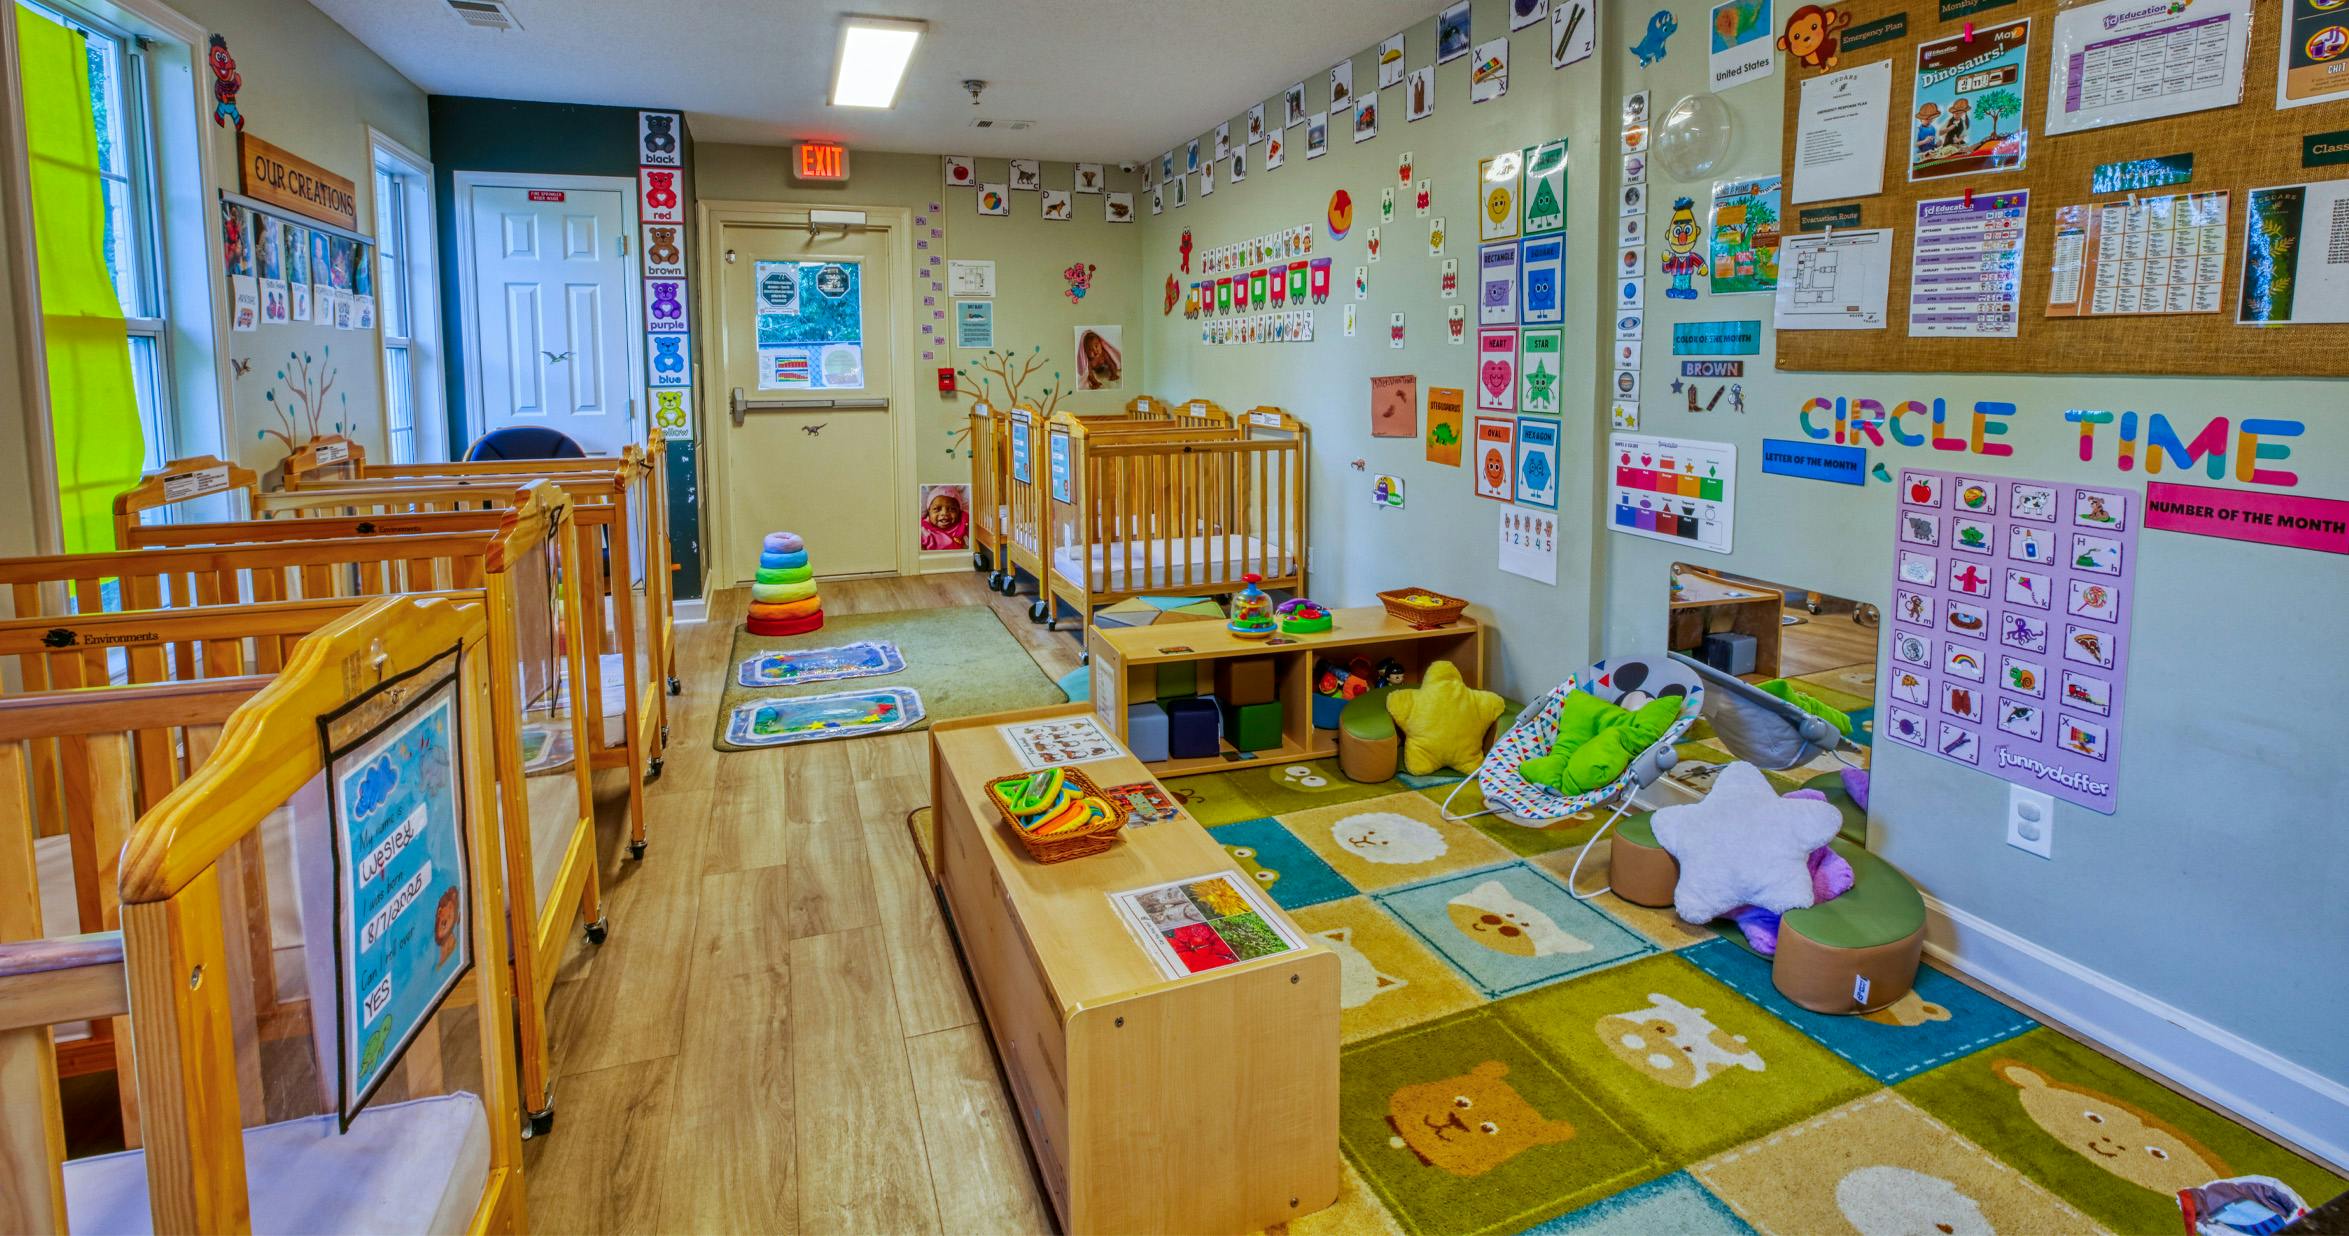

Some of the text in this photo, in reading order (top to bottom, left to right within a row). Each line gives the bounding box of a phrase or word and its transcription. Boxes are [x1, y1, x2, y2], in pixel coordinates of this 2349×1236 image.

[1942, 0, 1978, 12] Monthly
[1554, 8, 1562, 24] Z
[2119, 4, 2166, 21] Education
[1439, 12, 1447, 25] W
[1842, 22, 1904, 45] Emergency Plan
[1994, 29, 2018, 41] May
[1379, 46, 1386, 56] U
[1585, 41, 1591, 51] z
[1474, 49, 1482, 63] X
[1716, 58, 1769, 82] United States
[1922, 42, 2005, 88] Dinosaurs!
[2328, 62, 2346, 74] CHIT
[1408, 75, 1414, 85] V
[1830, 75, 1858, 85] CEDARS
[2313, 143, 2349, 154] Class
[646, 154, 675, 164] black
[801, 145, 843, 177] EXIT
[255, 155, 354, 217] OUR CREATIONS
[978, 184, 984, 192] B
[1042, 191, 1049, 199] D
[653, 211, 671, 220] red
[1801, 212, 1858, 225] Evacuation Route
[1485, 250, 1515, 264] RECTANGLE
[648, 265, 681, 275] brown
[650, 320, 685, 331] purple
[1489, 340, 1507, 349] HEART
[1534, 340, 1549, 349] STAR
[1676, 335, 1699, 343] COLOR
[1686, 363, 1738, 376] BROWN
[659, 375, 682, 384] blue
[1487, 429, 1501, 438] OVAL
[1524, 431, 1552, 442] HEXAGON
[1800, 396, 2306, 487] CIRCLE TIME
[1765, 452, 1857, 471] LETTER OF THE MONTH
[2078, 492, 2086, 500] D
[2150, 500, 2346, 534] NUMBER OF THE MONTH
[1514, 533, 1519, 545] 2
[1524, 536, 1530, 547] 3
[1535, 538, 1541, 550] 4
[1546, 541, 1551, 552] 5
[2078, 538, 2086, 546] H
[2009, 572, 2016, 580] K
[2074, 584, 2079, 592] L
[2070, 626, 2076, 634] P
[83, 632, 160, 646] Environments
[1897, 633, 1903, 641] Q
[1948, 644, 1953, 652] R
[2004, 658, 2010, 666] S
[2065, 672, 2072, 680] T
[2002, 699, 2010, 707] W
[2062, 718, 2070, 726] X
[1944, 726, 1950, 734] Z
[1999, 748, 2110, 796] funnydaffer
[360, 828, 374, 851] My
[376, 815, 394, 835] name
[362, 820, 414, 882] Wesley
[370, 891, 384, 911] was
[387, 871, 403, 894] born
[368, 872, 422, 944] 8/7/2025
[362, 969, 377, 991] Can
[400, 926, 415, 949] over
[365, 978, 390, 1018] YES
